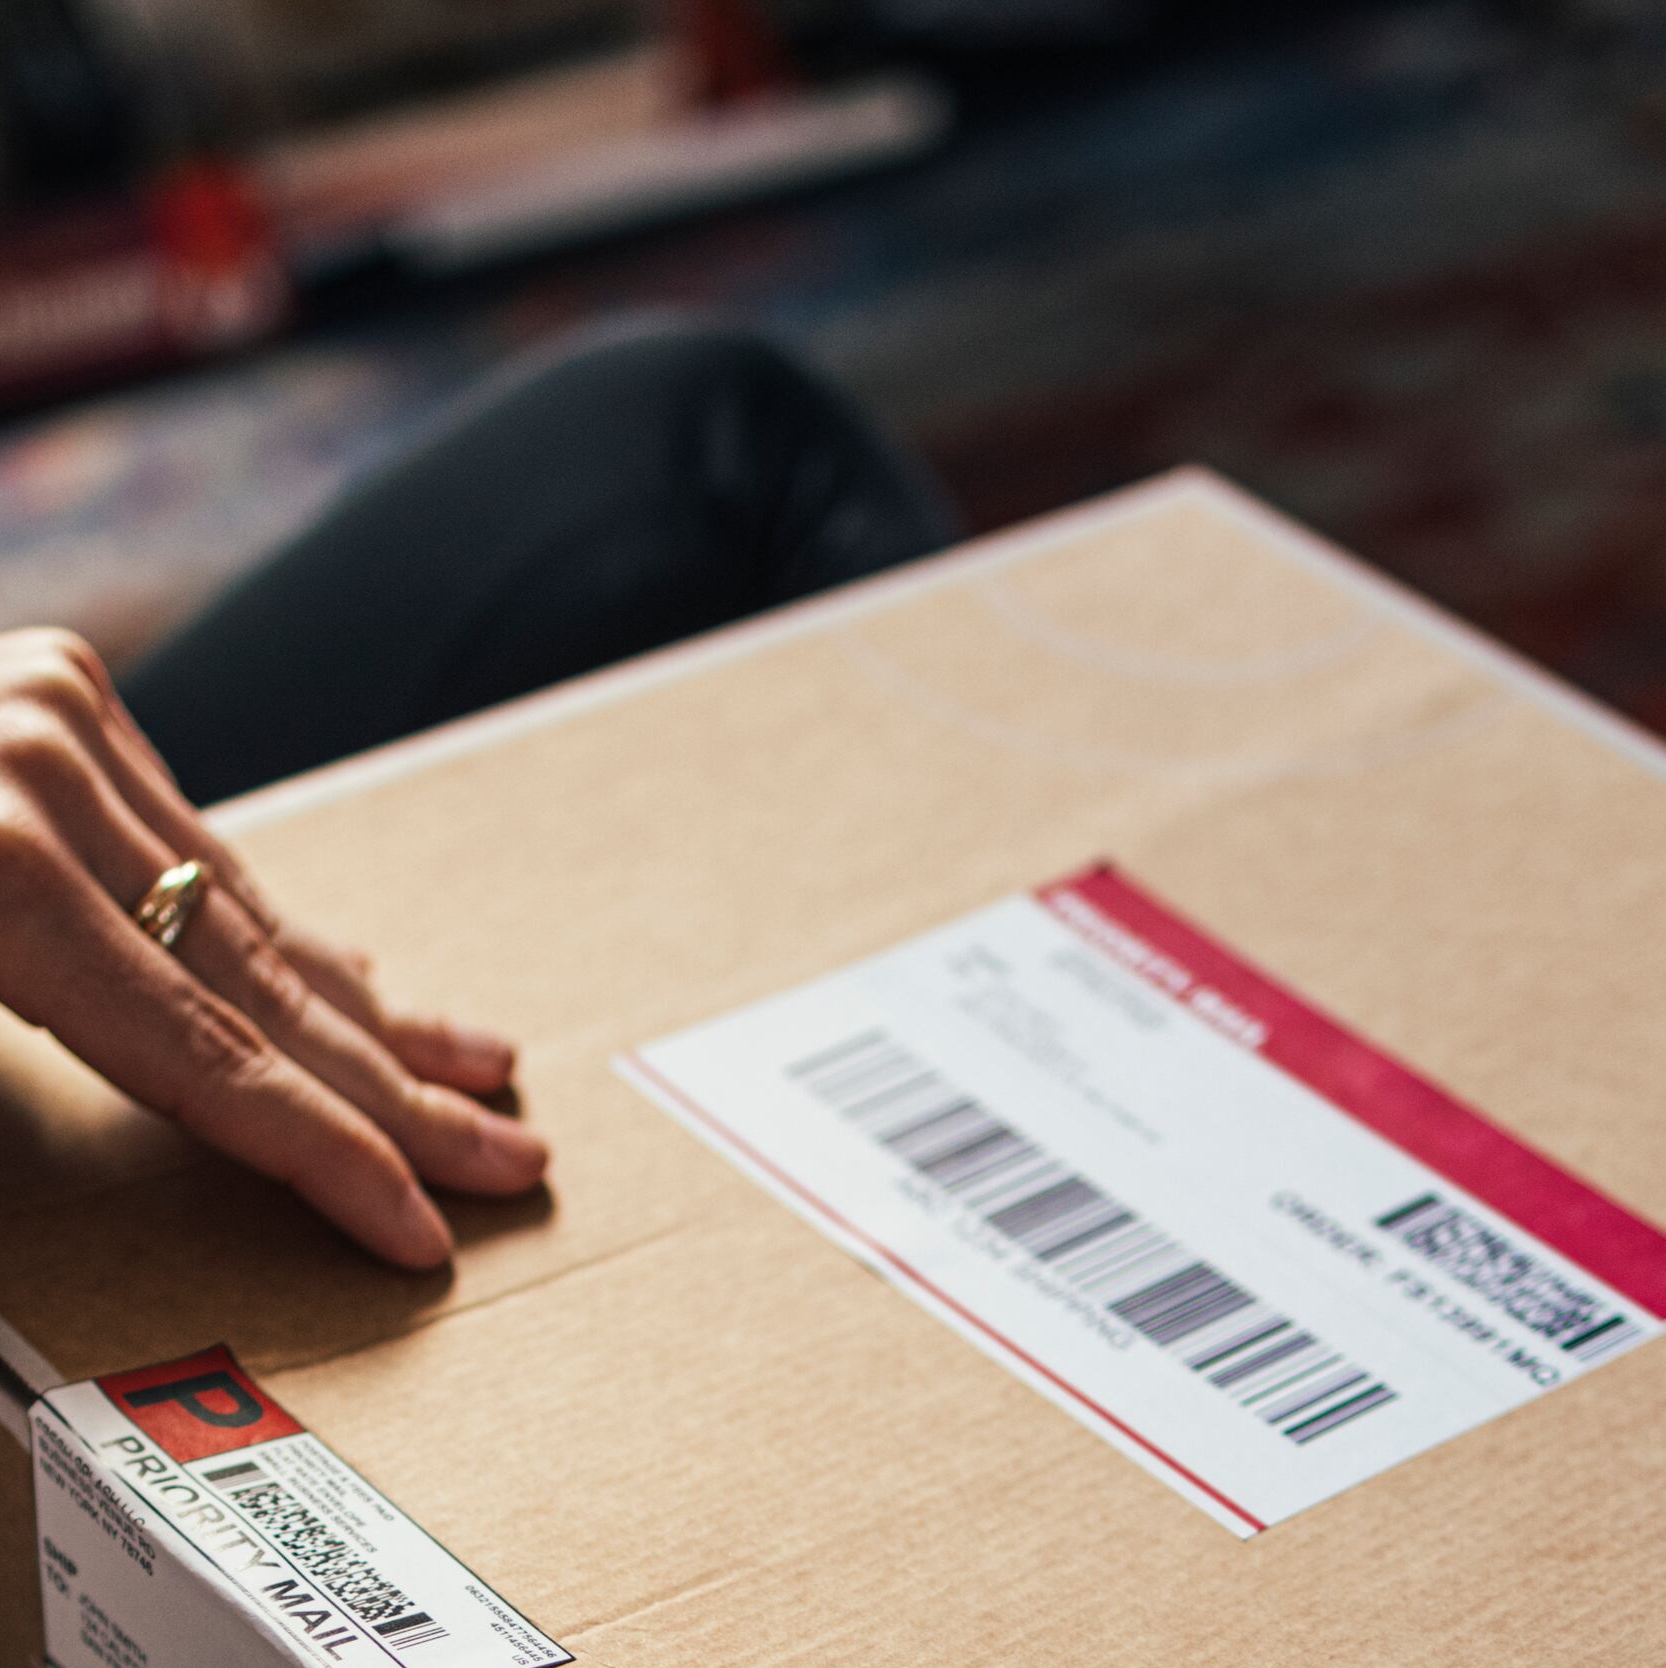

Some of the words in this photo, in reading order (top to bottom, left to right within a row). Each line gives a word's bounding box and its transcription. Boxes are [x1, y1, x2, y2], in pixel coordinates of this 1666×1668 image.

[123, 1371, 263, 1428] P
[101, 1517, 119, 1540] NY
[284, 1475, 335, 1515] BUSINESS
[328, 1513, 380, 1554] SERVICES
[100, 1436, 282, 1573] PRIORITY
[261, 1578, 359, 1661] MAIL
[511, 1654, 529, 1665] US
